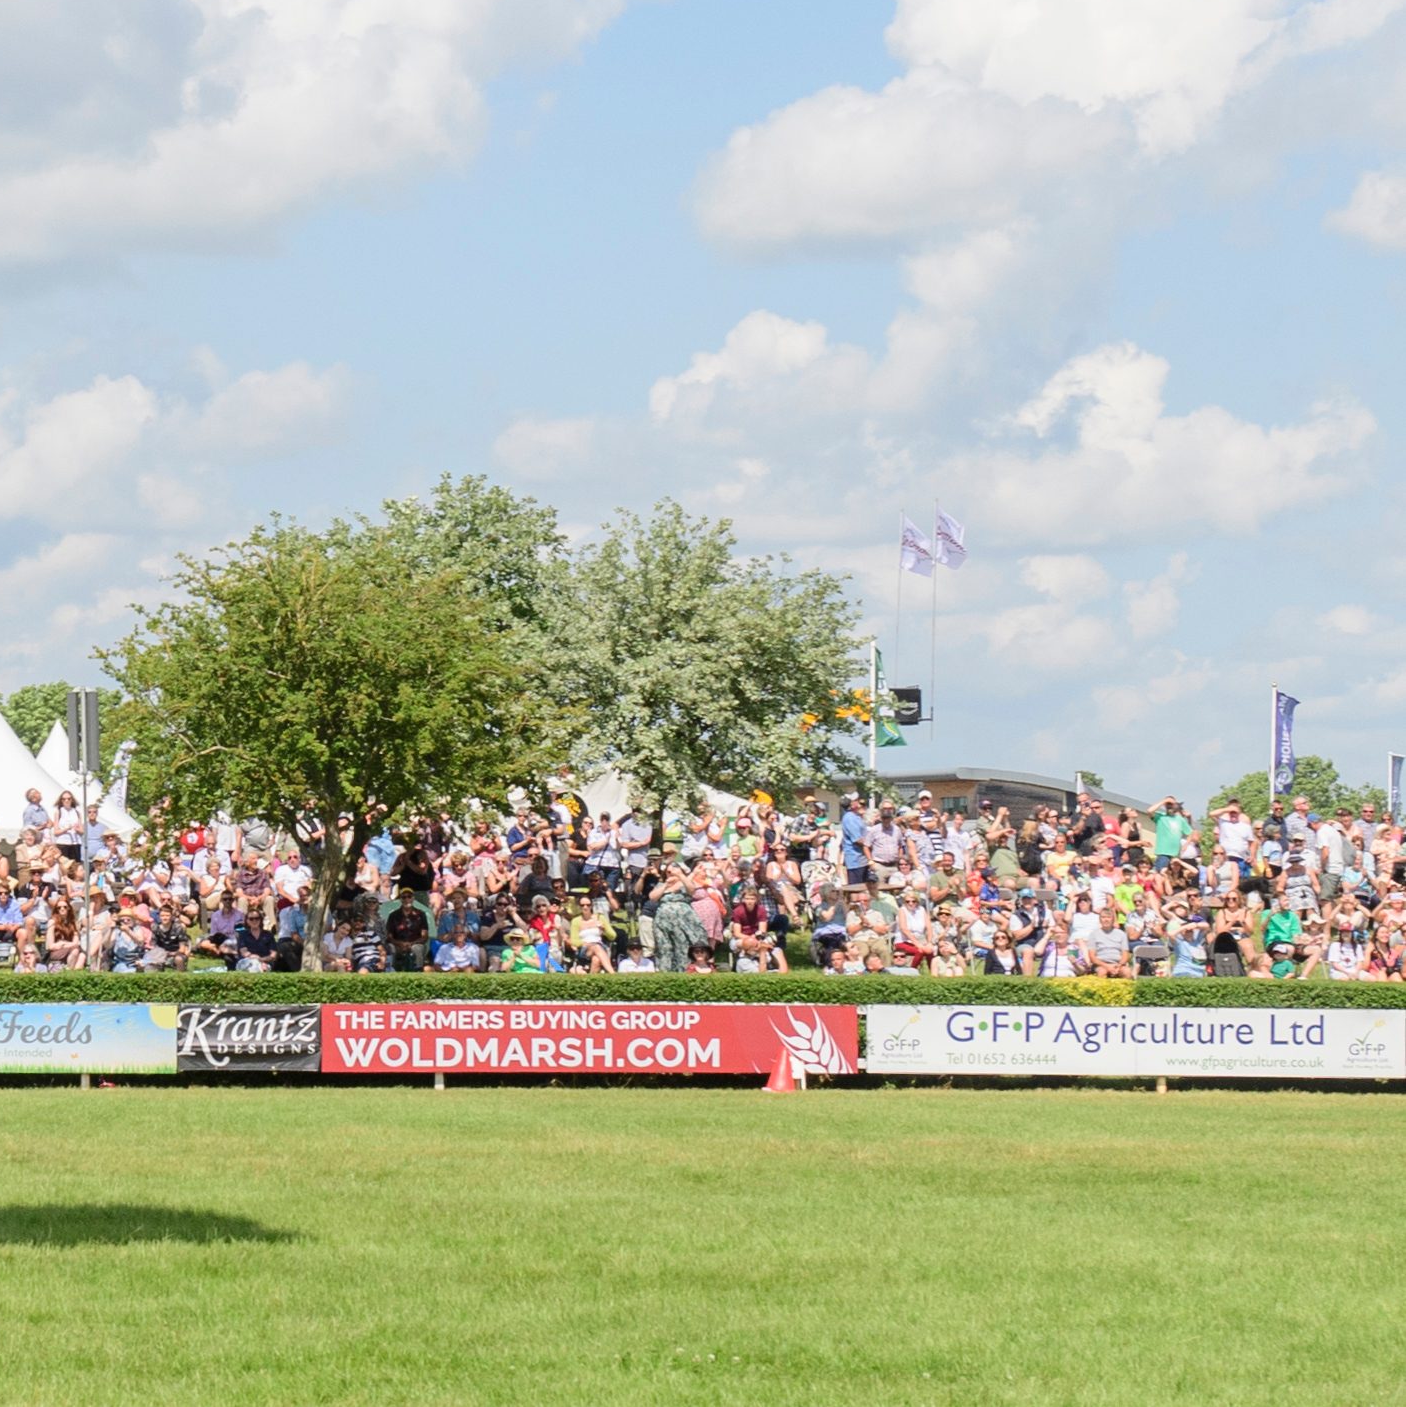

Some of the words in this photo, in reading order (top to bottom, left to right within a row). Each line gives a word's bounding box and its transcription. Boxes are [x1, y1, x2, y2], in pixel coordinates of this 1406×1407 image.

[334, 1010, 386, 1030] THE
[389, 1010, 505, 1030] FARMERS
[509, 1010, 607, 1030] BUYING
[610, 1010, 701, 1030] GROUP
[177, 1007, 318, 1067] Krantz
[1053, 1011, 1255, 1053] Agriculture
[1270, 1014, 1325, 1045] Ltd
[3, 1047, 53, 1059] Intended
[217, 1043, 316, 1054] DESIGNS
[334, 1037, 721, 1068] WOLDMARSH.COM
[945, 1052, 964, 1064] Tel
[967, 1052, 1007, 1065] 01652
[1010, 1052, 1058, 1065] 636444
[1165, 1055, 1325, 1071] www.gfpagriculture.co.uk
